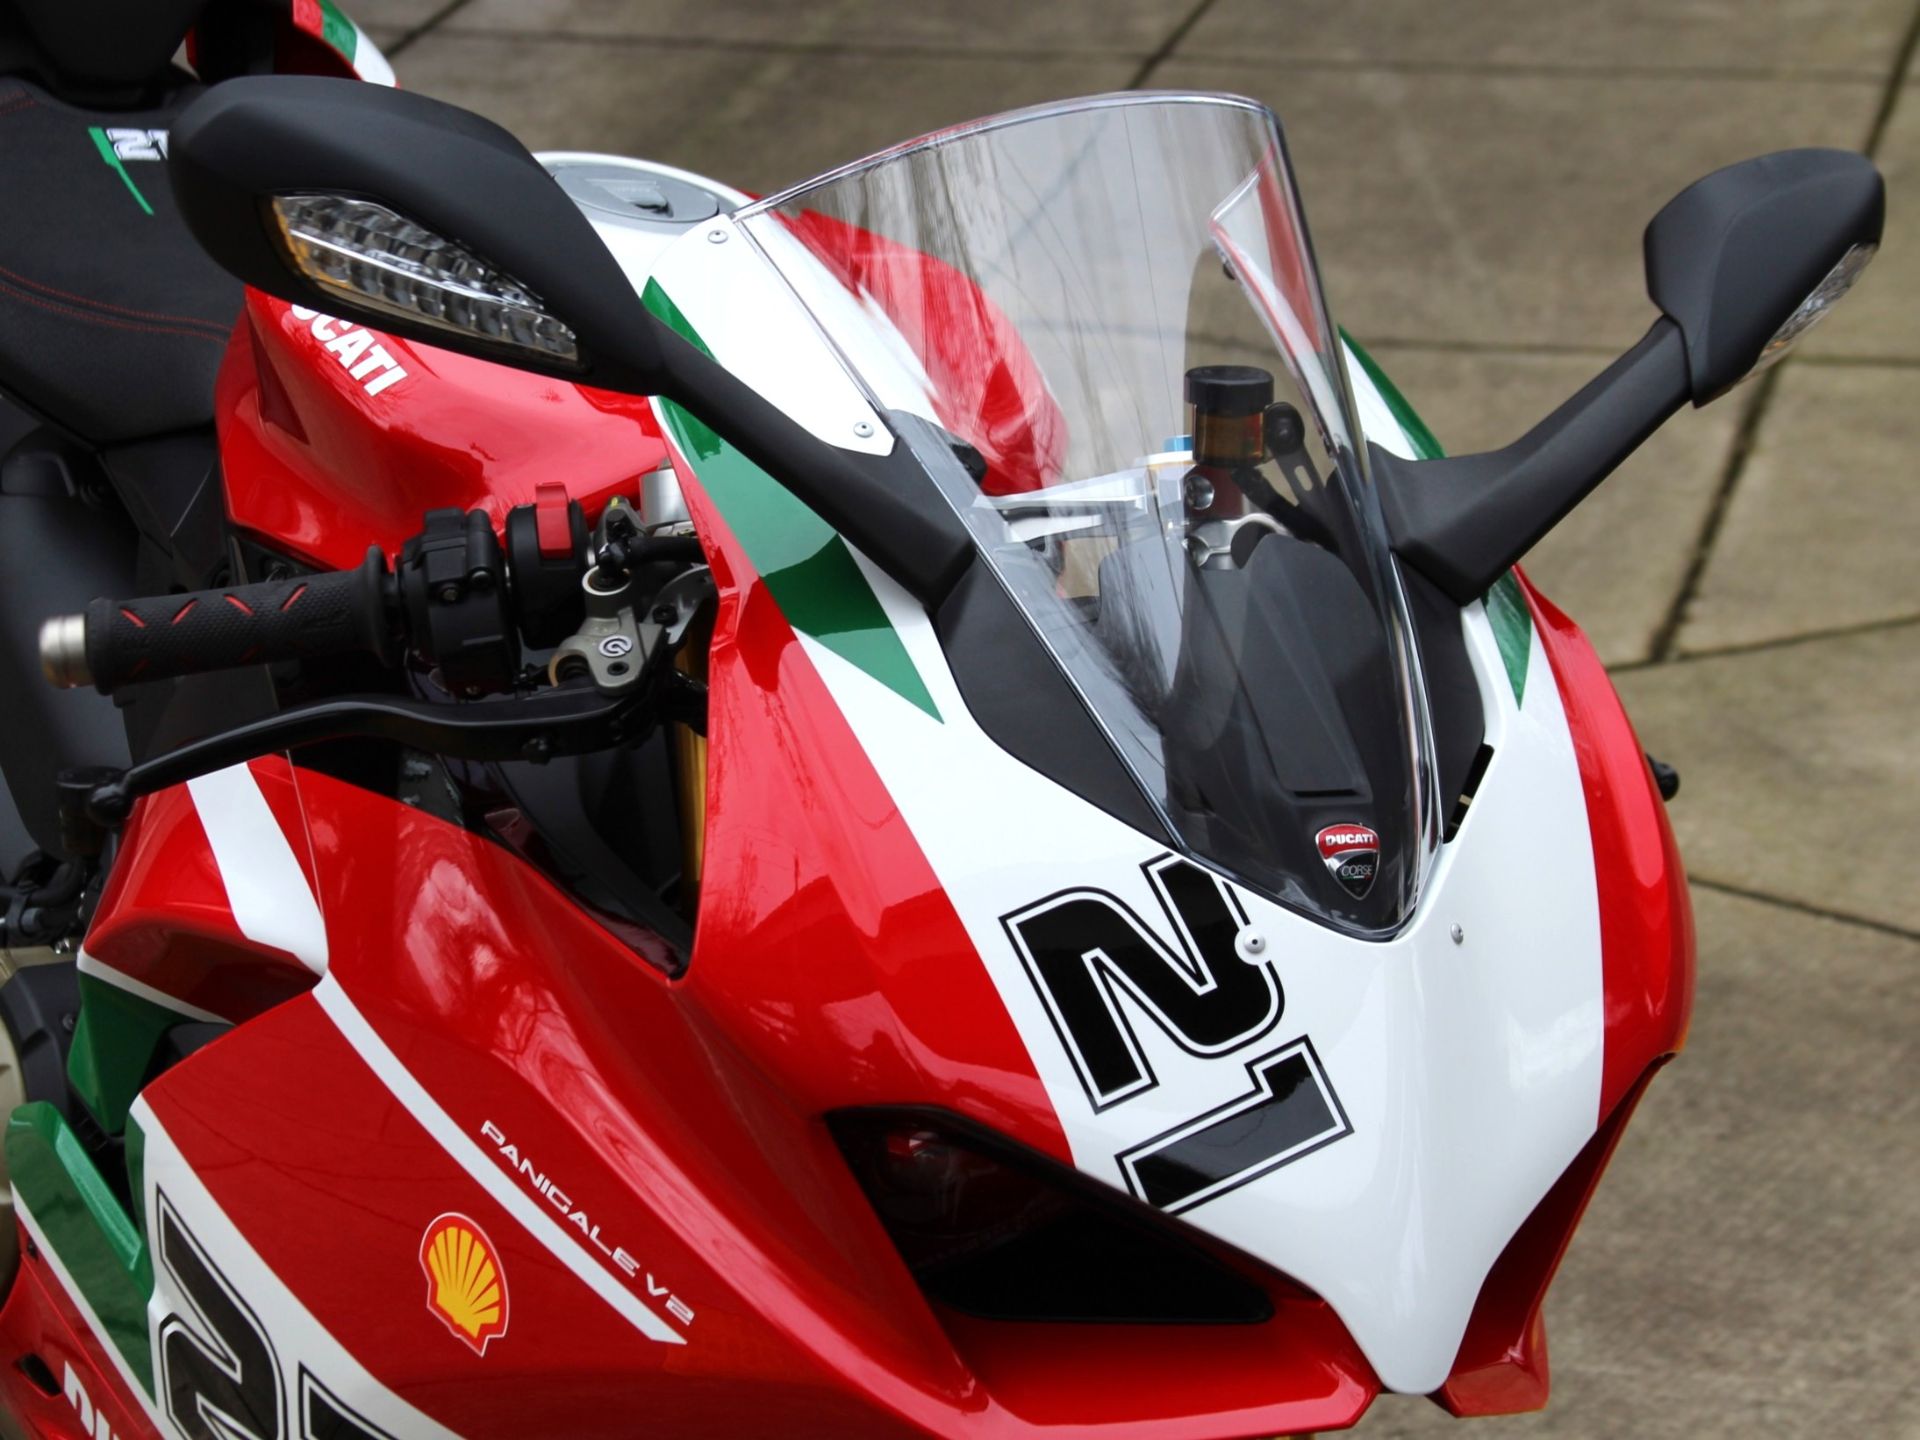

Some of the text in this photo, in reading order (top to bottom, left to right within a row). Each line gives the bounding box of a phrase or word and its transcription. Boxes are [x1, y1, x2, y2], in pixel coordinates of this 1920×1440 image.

[1325, 833, 1374, 847] DUCATI
[1341, 865, 1373, 877] CORSE
[998, 851, 1355, 1217] 21
[481, 1119, 695, 1326] PANIGALE V2
